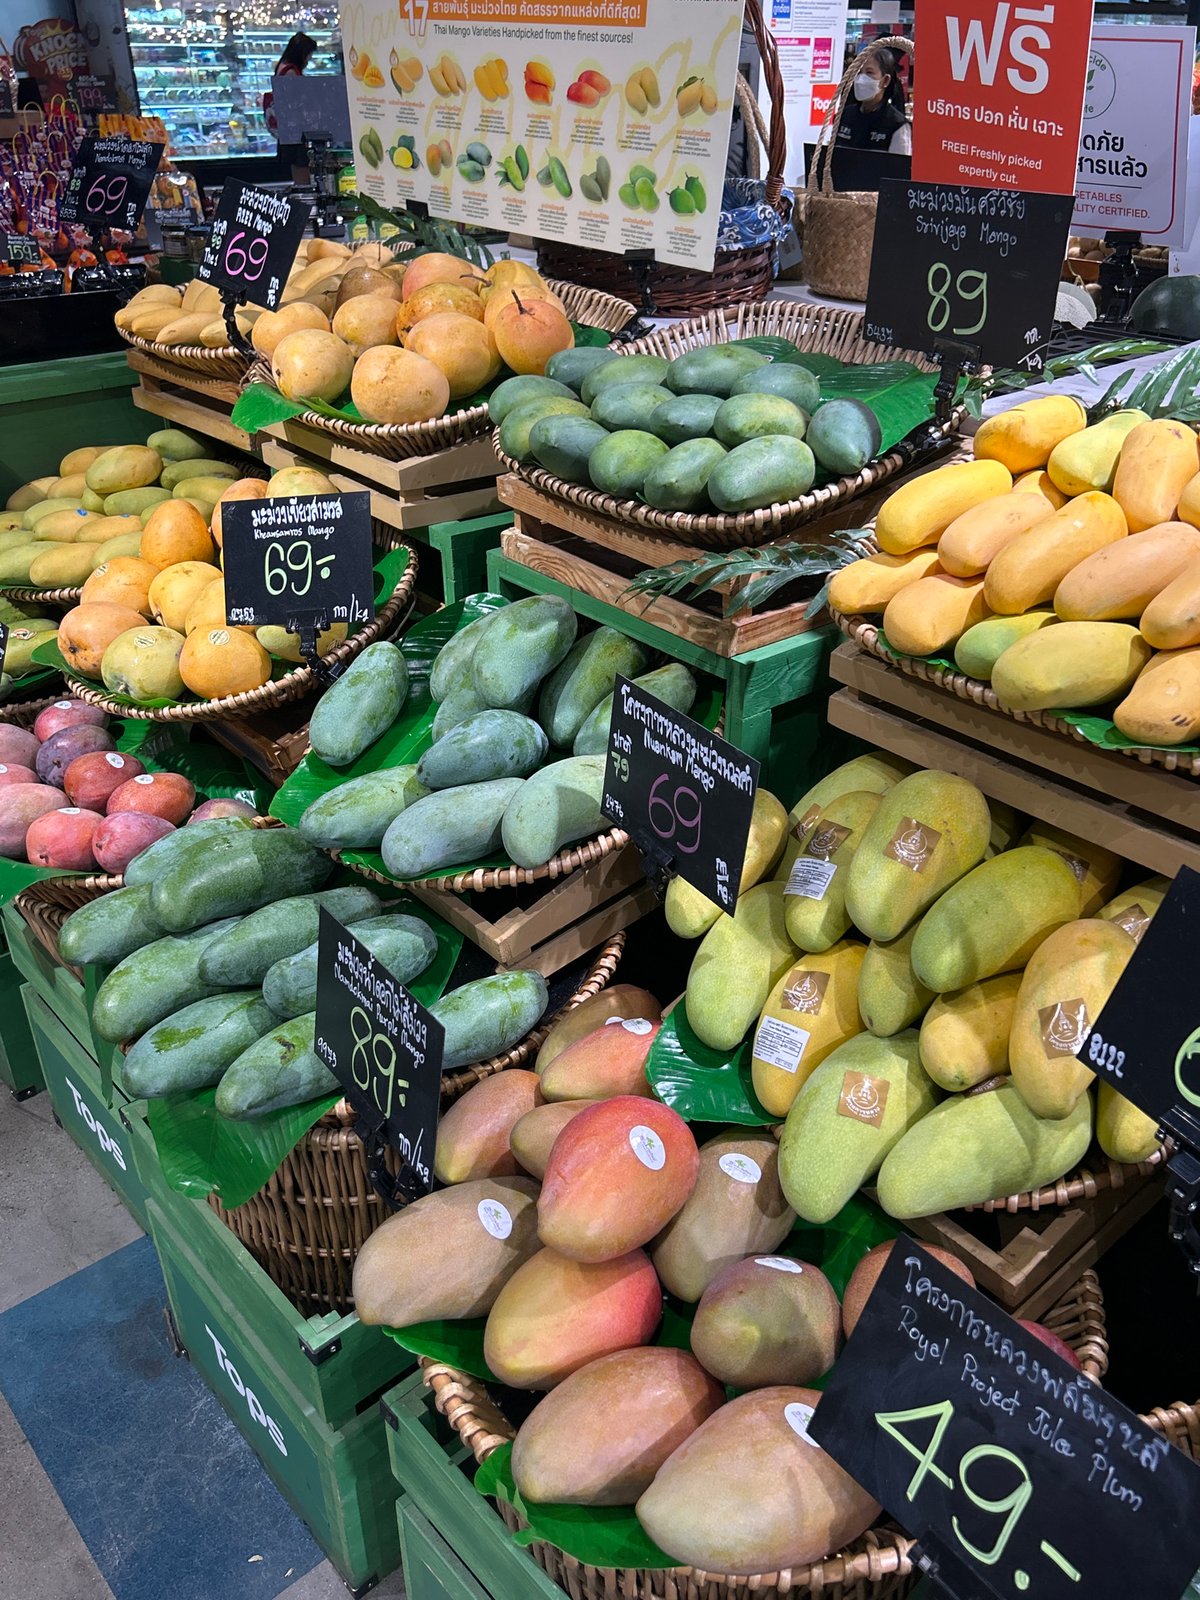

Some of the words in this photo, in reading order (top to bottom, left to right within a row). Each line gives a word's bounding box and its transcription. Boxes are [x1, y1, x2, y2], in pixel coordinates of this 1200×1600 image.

[403, 0, 429, 36] 17
[434, 24, 447, 35] Thai
[449, 25, 471, 38] Mango
[472, 26, 500, 37] Varieties
[502, 26, 543, 40] Handpicked
[545, 29, 562, 40] from
[564, 30, 576, 41] the
[578, 30, 598, 42] finest
[600, 32, 633, 43] sources!
[945, 2, 1055, 95] ฟรี
[812, 97, 833, 113] Top
[927, 99, 970, 120] บริการ
[974, 106, 1004, 126] ปอก
[1008, 106, 1028, 131] หั่น
[1033, 118, 1064, 137] เฉาะ
[942, 140, 969, 155] FREE!
[971, 146, 1006, 164] Freshly
[1008, 154, 1042, 170] picked
[1081, 130, 1124, 153] ดภัย
[959, 163, 998, 181] expertly
[1000, 172, 1018, 184] cut.
[86, 174, 128, 215] 69
[1074, 189, 1122, 203] GETABLES
[1098, 205, 1151, 219] CERTIFIED.
[225, 231, 269, 281] 69
[927, 262, 988, 335] 89
[307, 525, 335, 540] Mango
[611, 751, 630, 783] 79
[648, 773, 702, 854] 69
[65, 1076, 127, 1172] Tops
[205, 1323, 287, 1457] Tops
[898, 1305, 951, 1364] Royal
[960, 1354, 1021, 1416] Project
[1087, 1453, 1143, 1513] Plum
